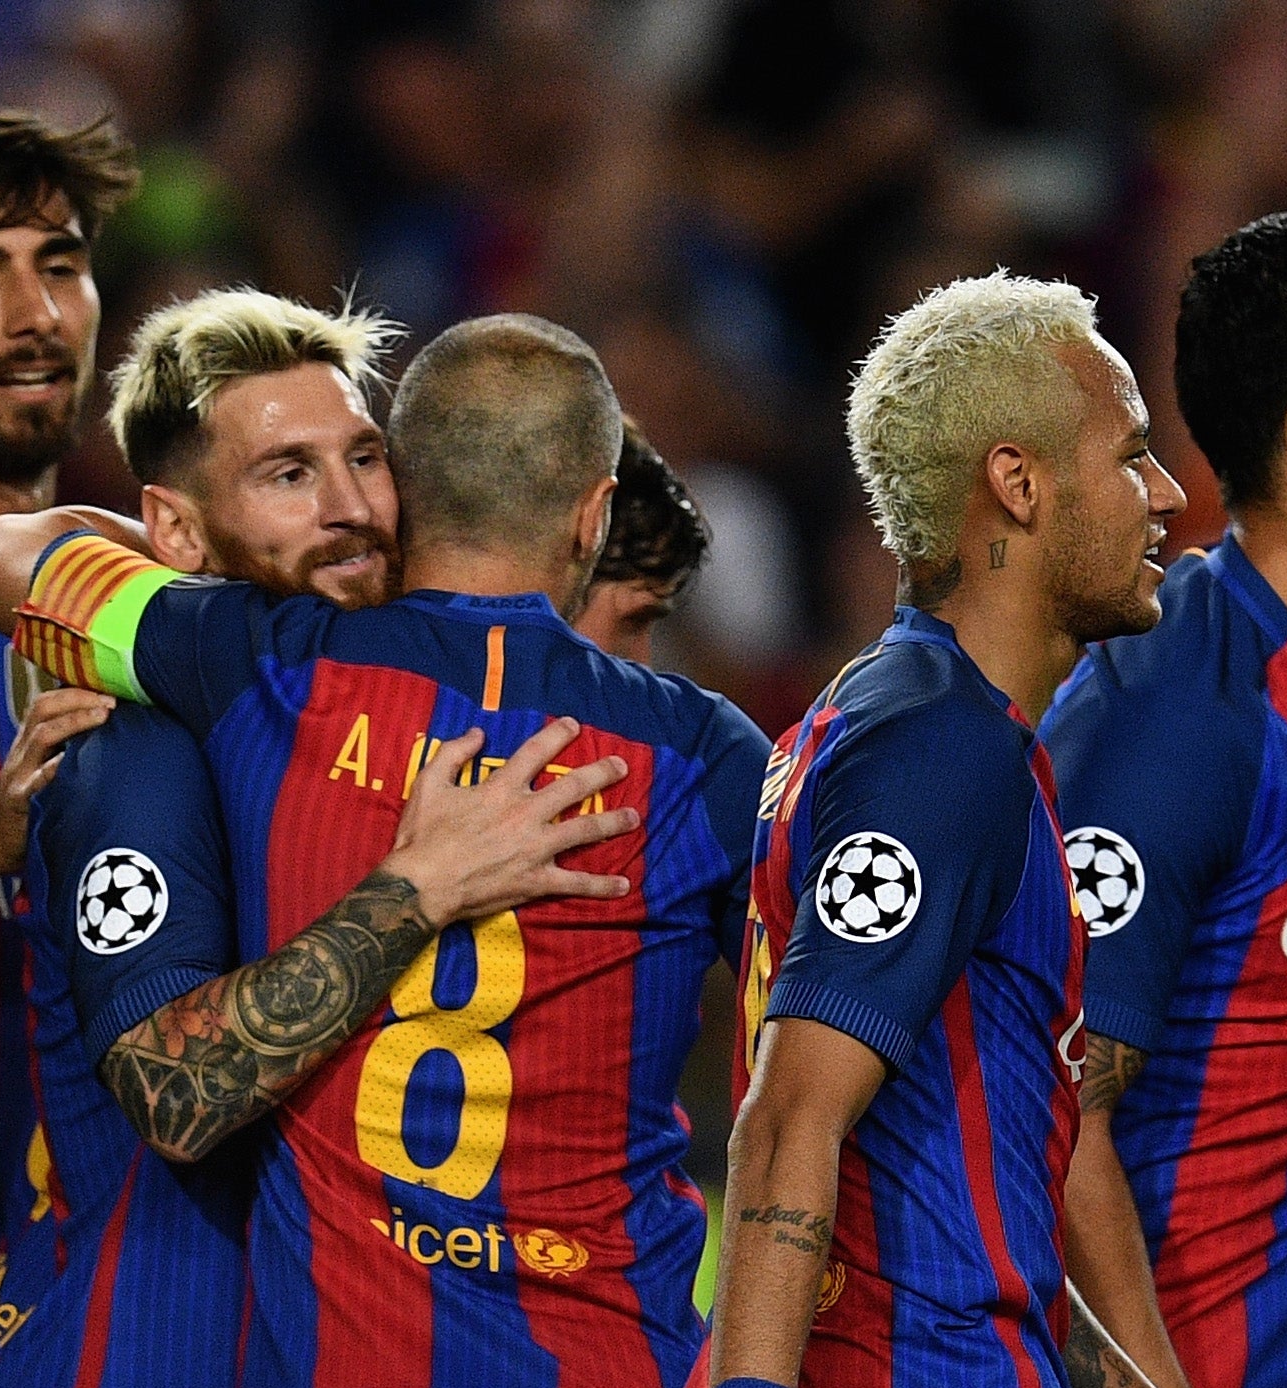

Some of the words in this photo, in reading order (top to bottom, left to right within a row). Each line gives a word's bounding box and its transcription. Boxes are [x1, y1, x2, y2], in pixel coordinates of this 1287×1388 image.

[328, 713, 384, 791] A.
[354, 909, 525, 1201] 8
[370, 1206, 505, 1273] icef
